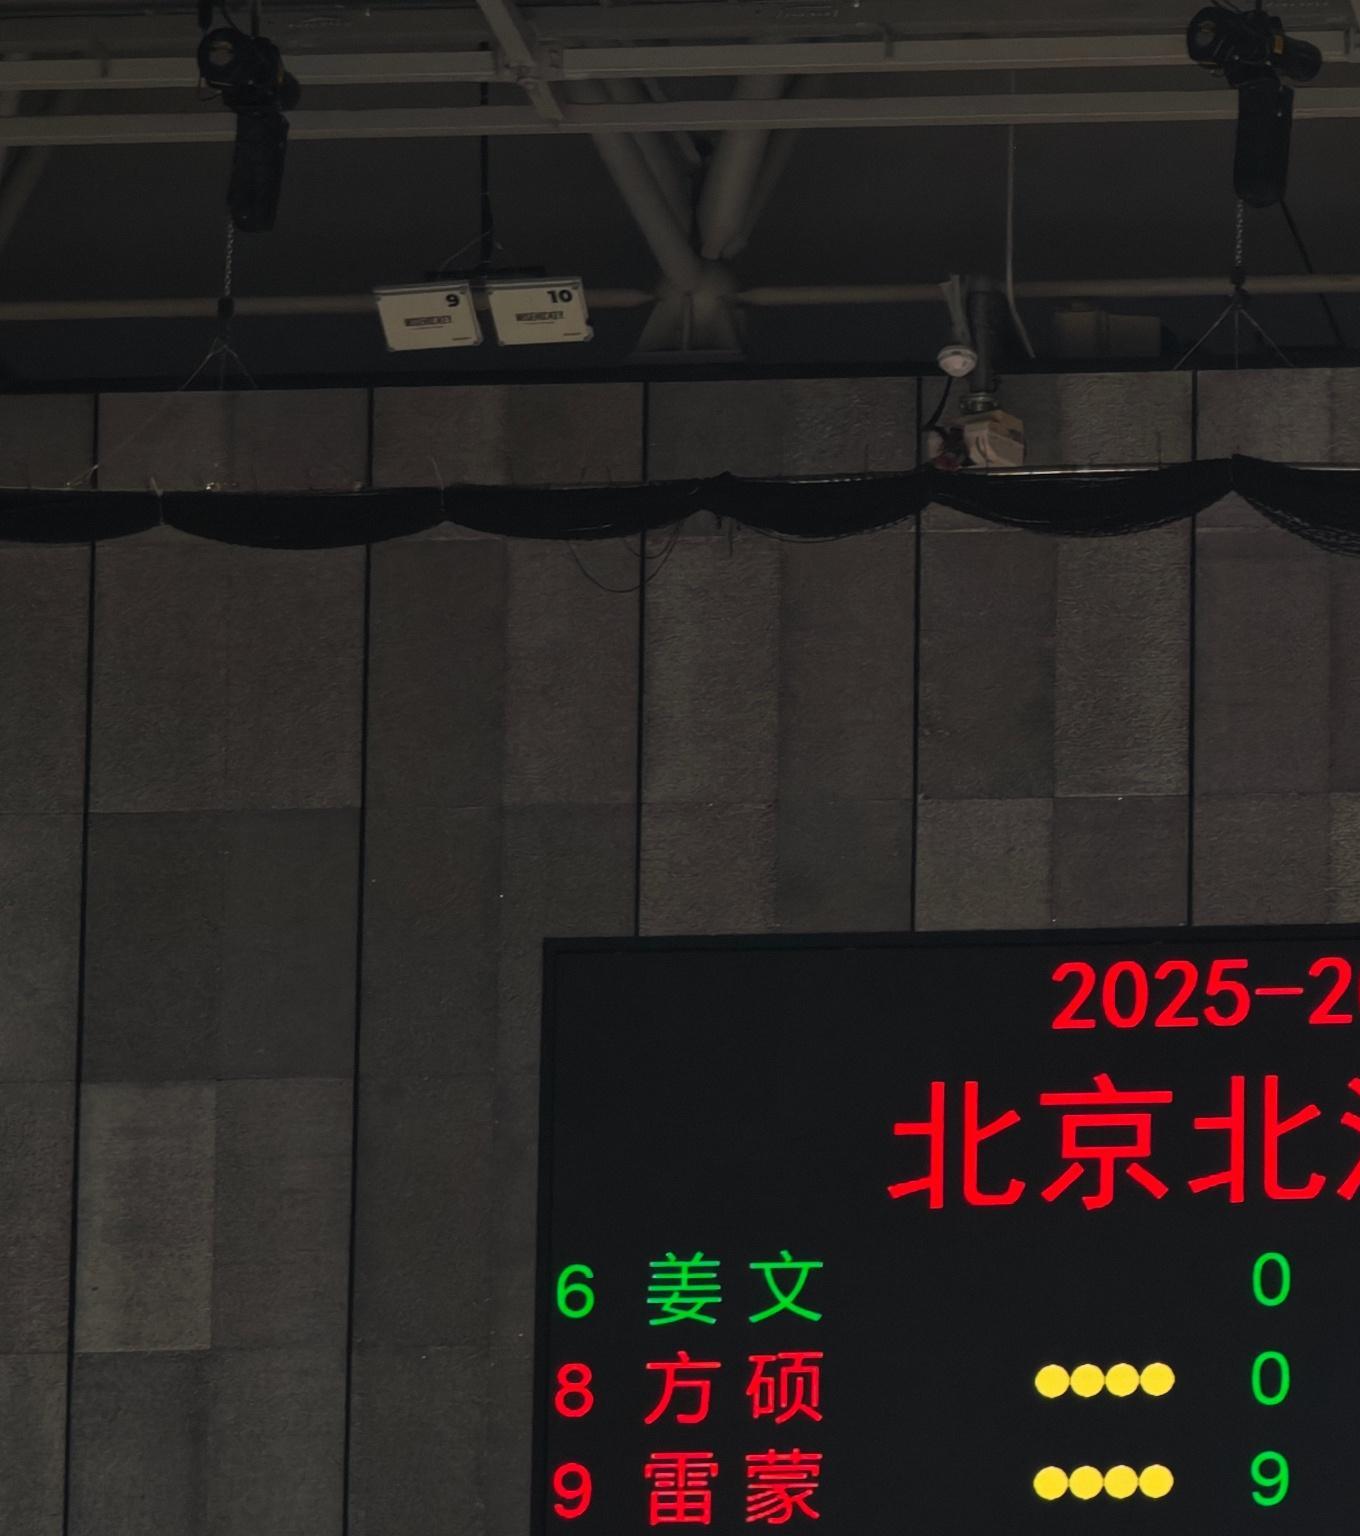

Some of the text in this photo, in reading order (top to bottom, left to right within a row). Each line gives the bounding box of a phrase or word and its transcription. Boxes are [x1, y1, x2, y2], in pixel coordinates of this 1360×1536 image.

[445, 293, 461, 308] 9
[547, 289, 574, 304] 10
[556, 1264, 595, 1319] 6
[1252, 1252, 1291, 1307] 0
[554, 1363, 594, 1418] 8
[1251, 1350, 1290, 1406] 0
[552, 1462, 593, 1520] 9
[1250, 1450, 1289, 1507] 9
